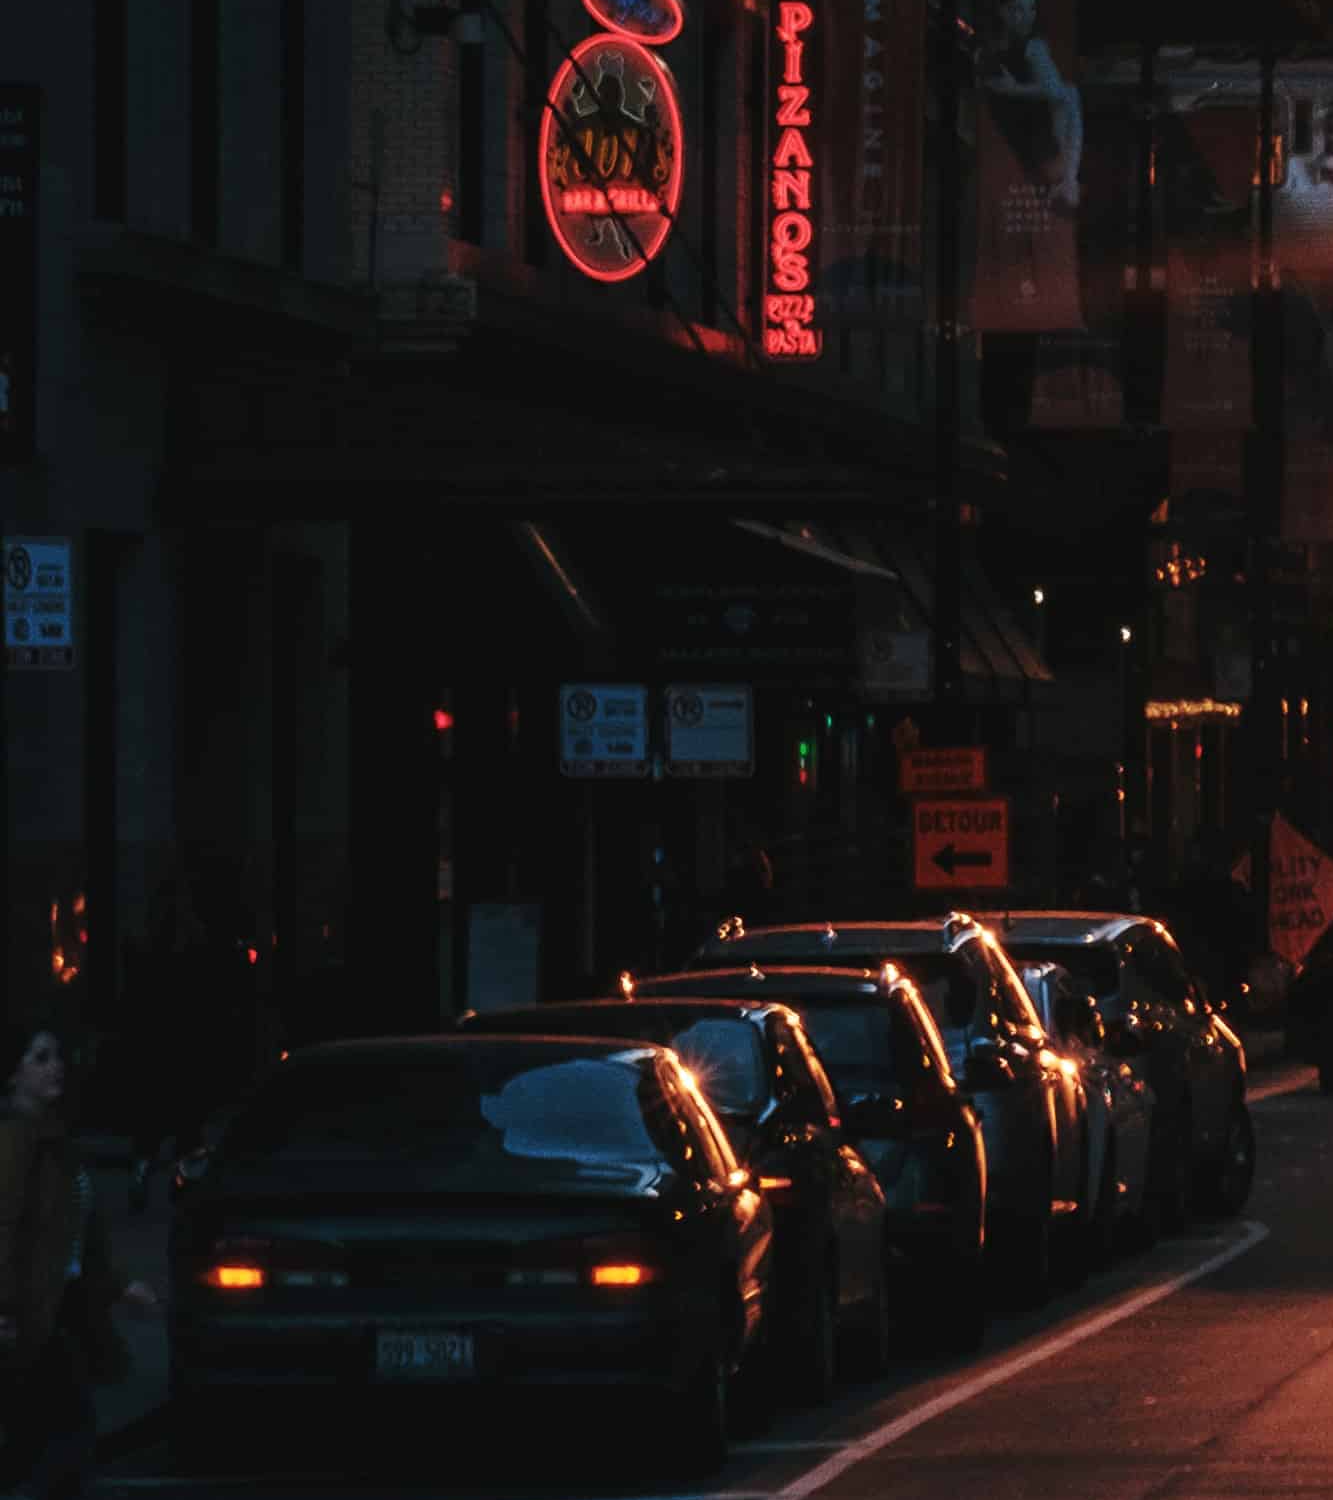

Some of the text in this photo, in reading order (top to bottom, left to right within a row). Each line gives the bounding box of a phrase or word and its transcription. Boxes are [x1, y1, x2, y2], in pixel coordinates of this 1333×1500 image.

[766, 330, 817, 354] PASTA
[918, 810, 1002, 833] DETOUR
[1272, 908, 1326, 930] HEAD
